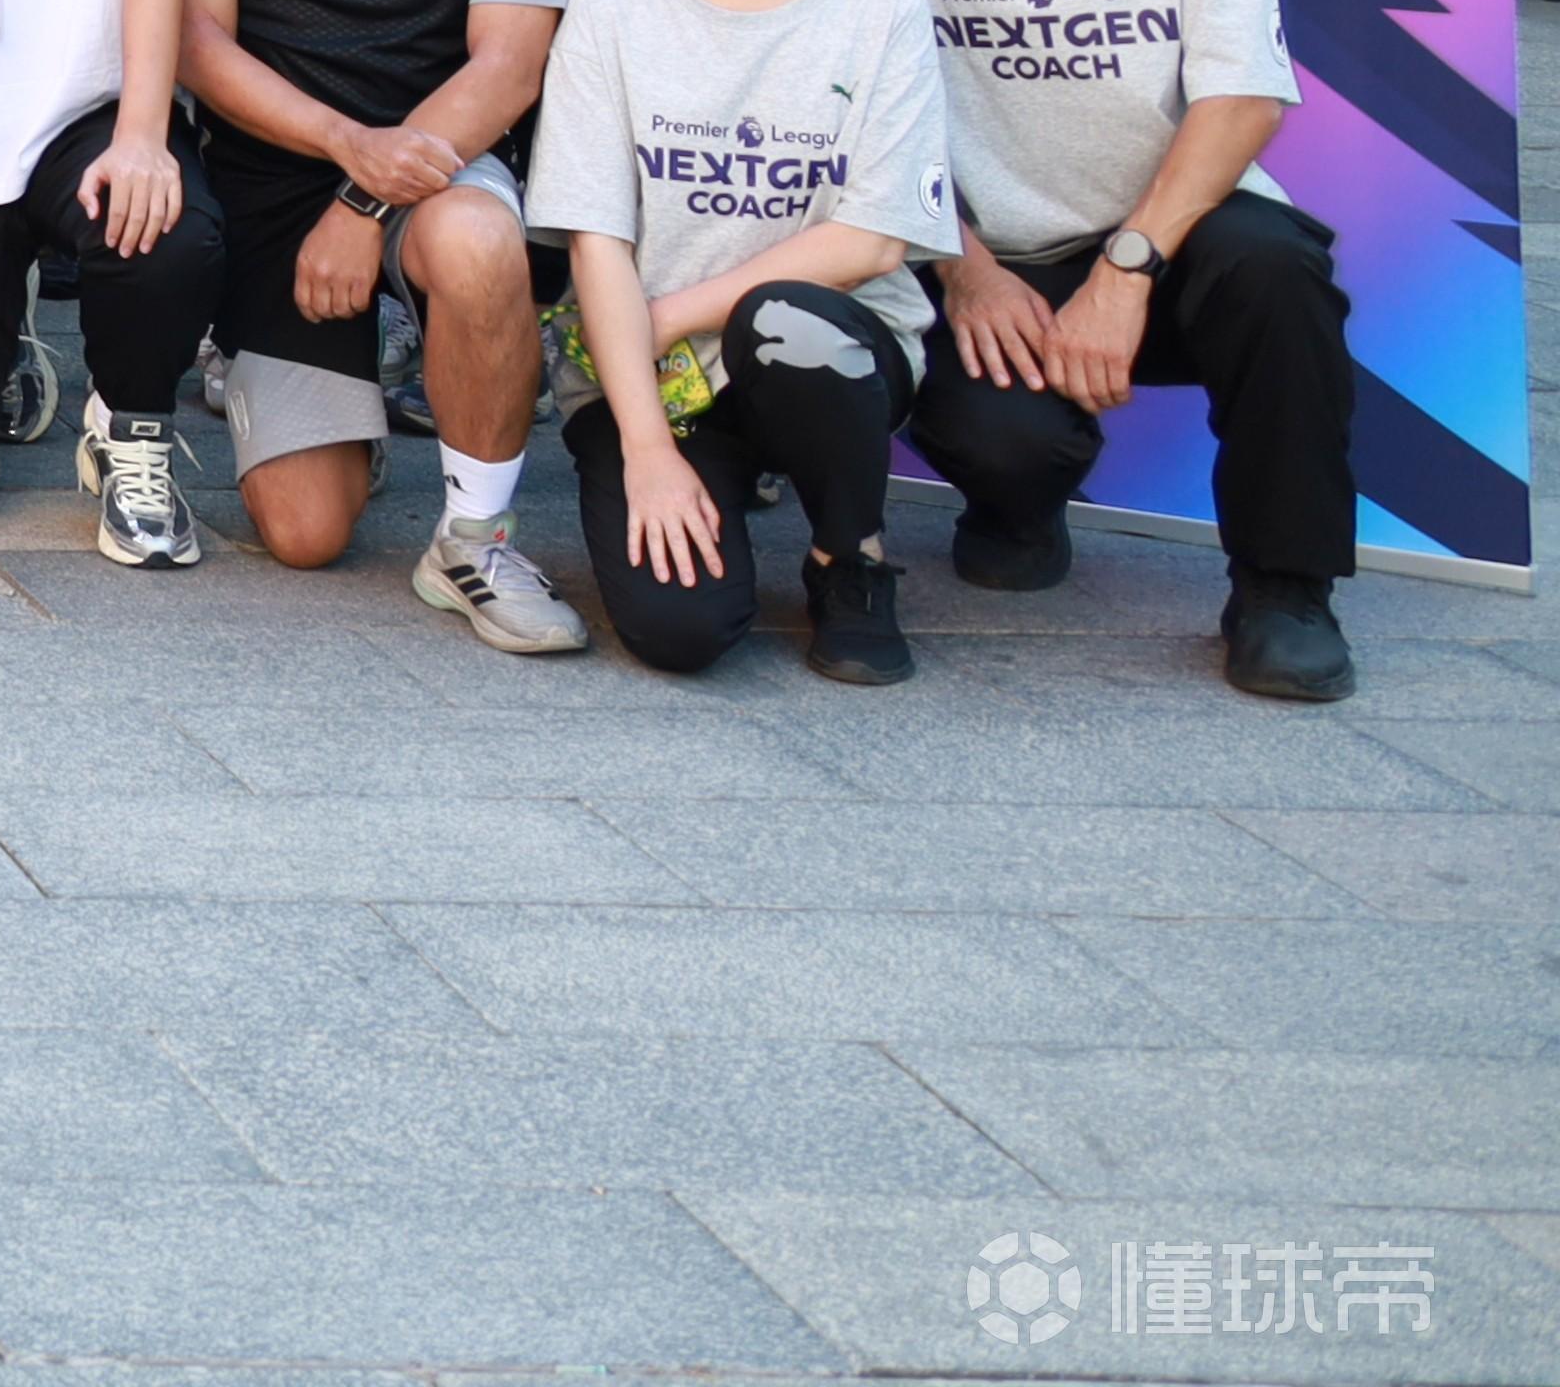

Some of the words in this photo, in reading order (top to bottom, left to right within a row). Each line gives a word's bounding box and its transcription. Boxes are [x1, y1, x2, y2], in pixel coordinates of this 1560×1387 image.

[932, 6, 1181, 51] NEXTGEN
[990, 53, 1122, 82] COACH
[652, 115, 729, 139] Premier
[771, 125, 838, 149] Leagu
[686, 189, 812, 220] COACH
